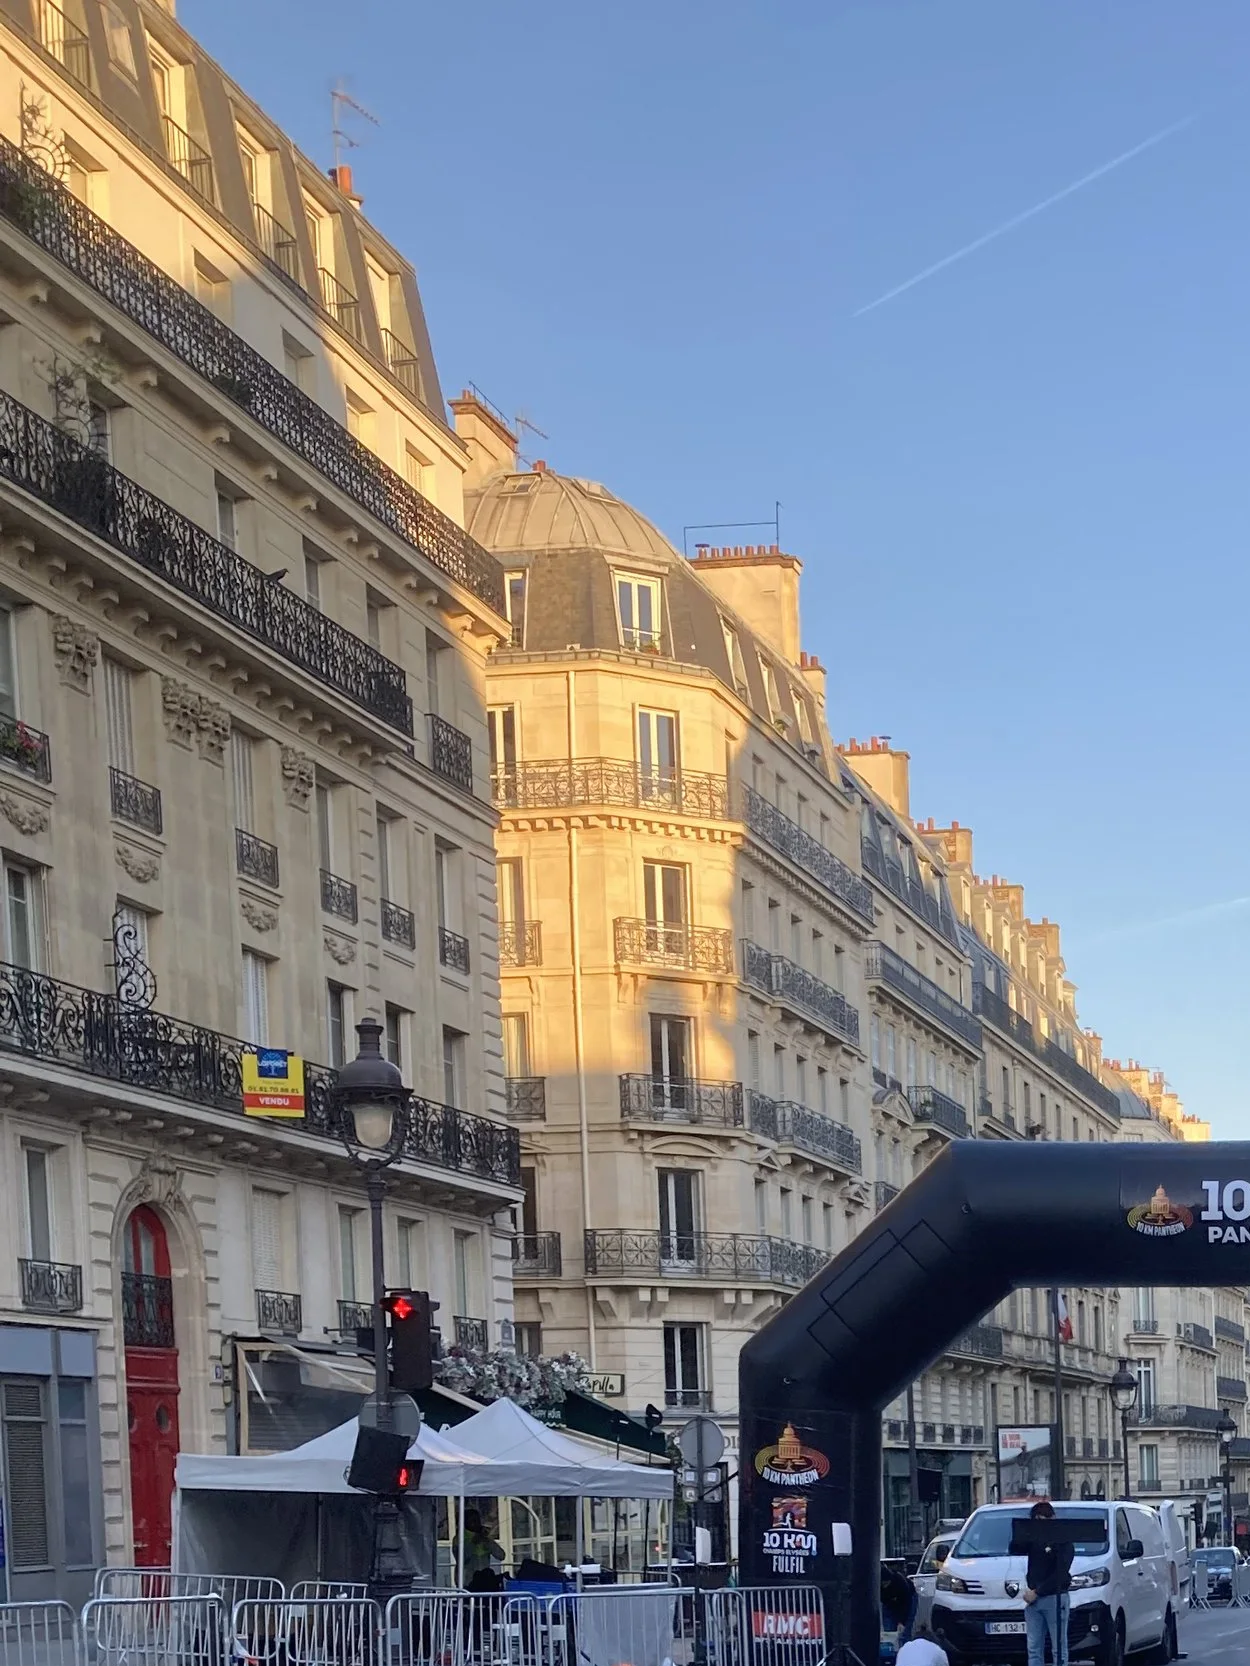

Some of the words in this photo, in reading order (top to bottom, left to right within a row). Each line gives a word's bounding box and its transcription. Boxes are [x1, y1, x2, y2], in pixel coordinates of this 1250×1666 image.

[259, 1097, 289, 1106] VENDU
[1154, 1222, 1186, 1236] PANTHEON
[781, 1468, 819, 1486] PANTHEON
[763, 1532, 780, 1548] 10
[783, 1533, 817, 1553] KM
[772, 1555, 806, 1574] FULFIL
